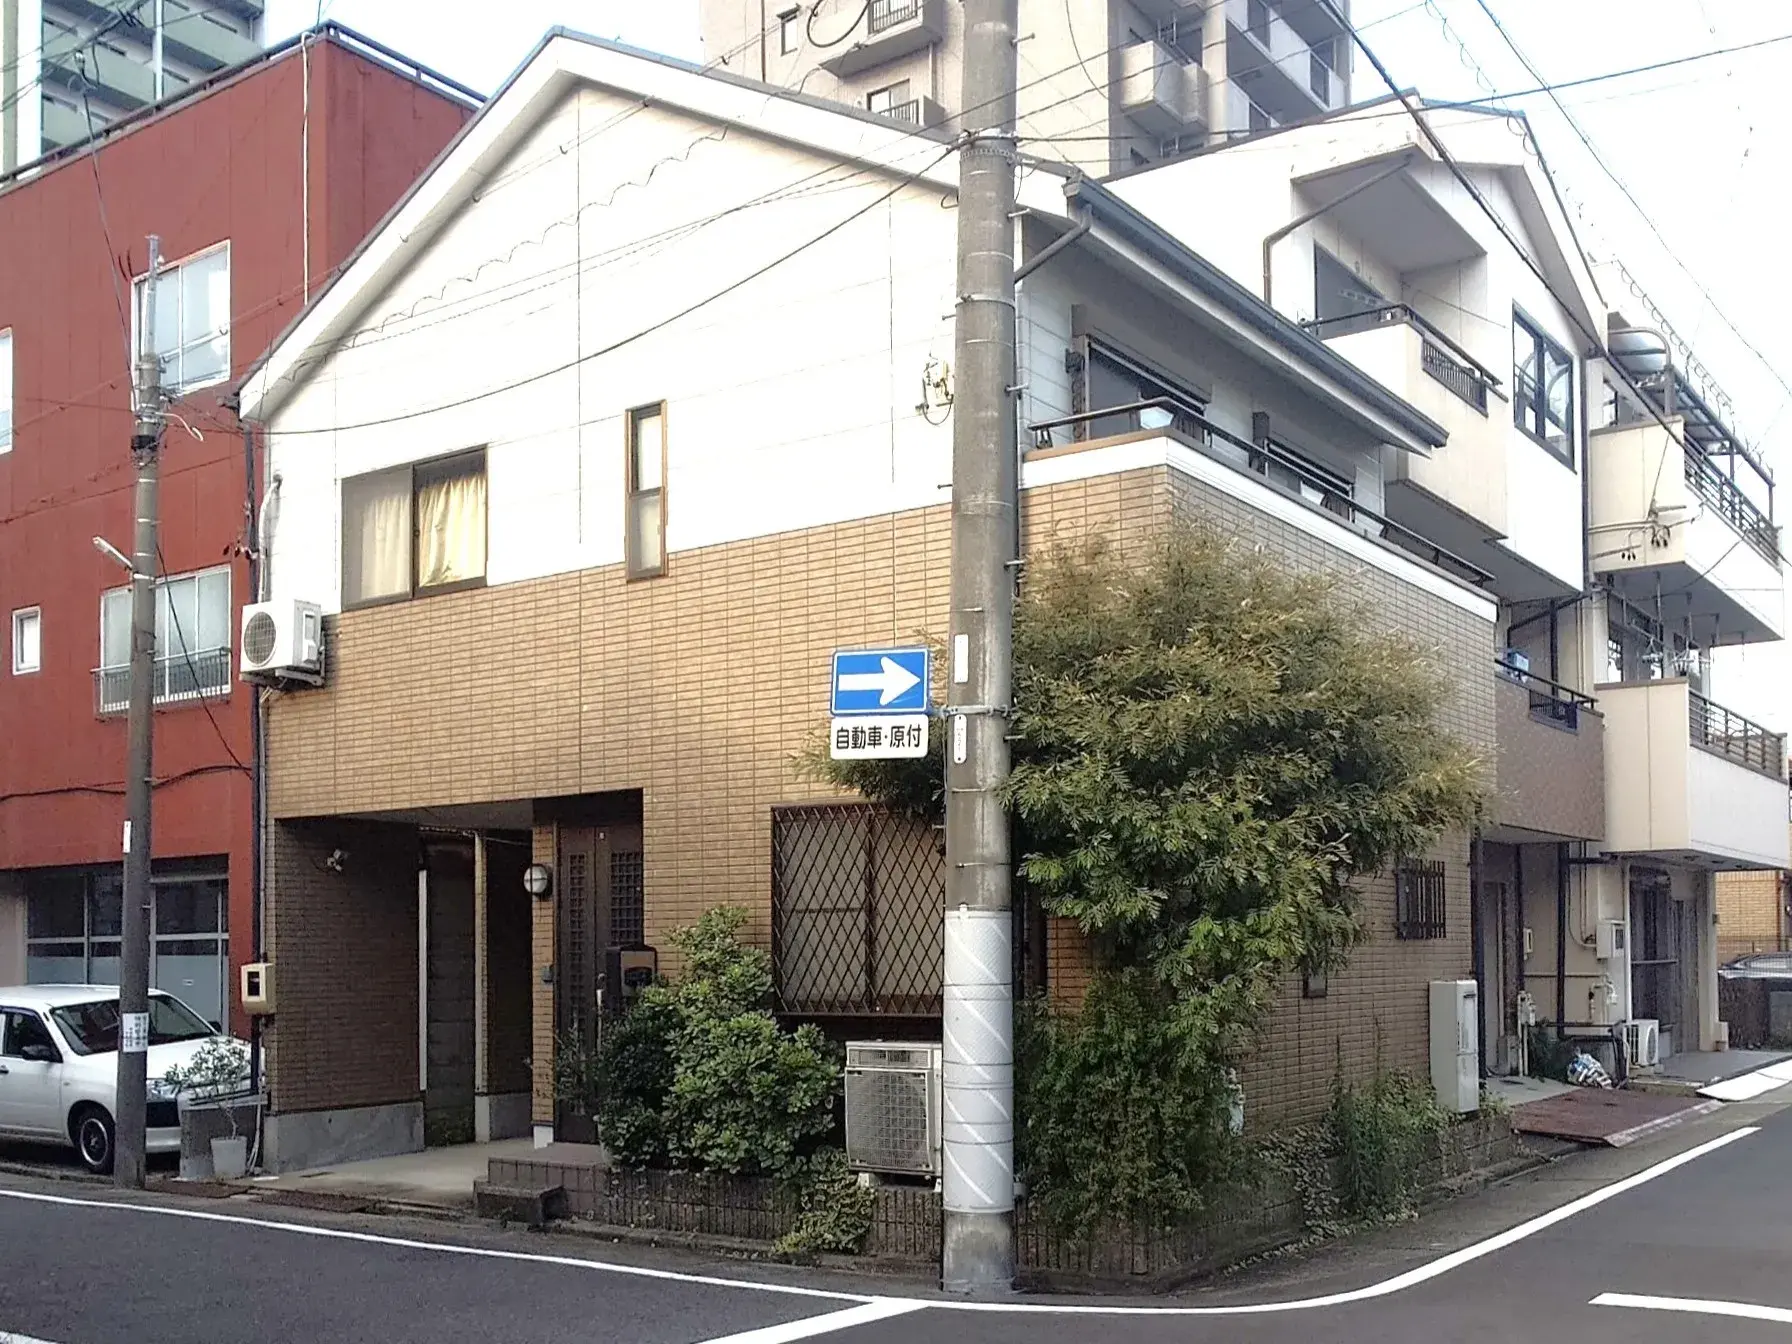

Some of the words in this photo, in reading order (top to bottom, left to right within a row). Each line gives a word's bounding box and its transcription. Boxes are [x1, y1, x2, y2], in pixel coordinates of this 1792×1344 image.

[836, 724, 922, 750] 自動車・原付
